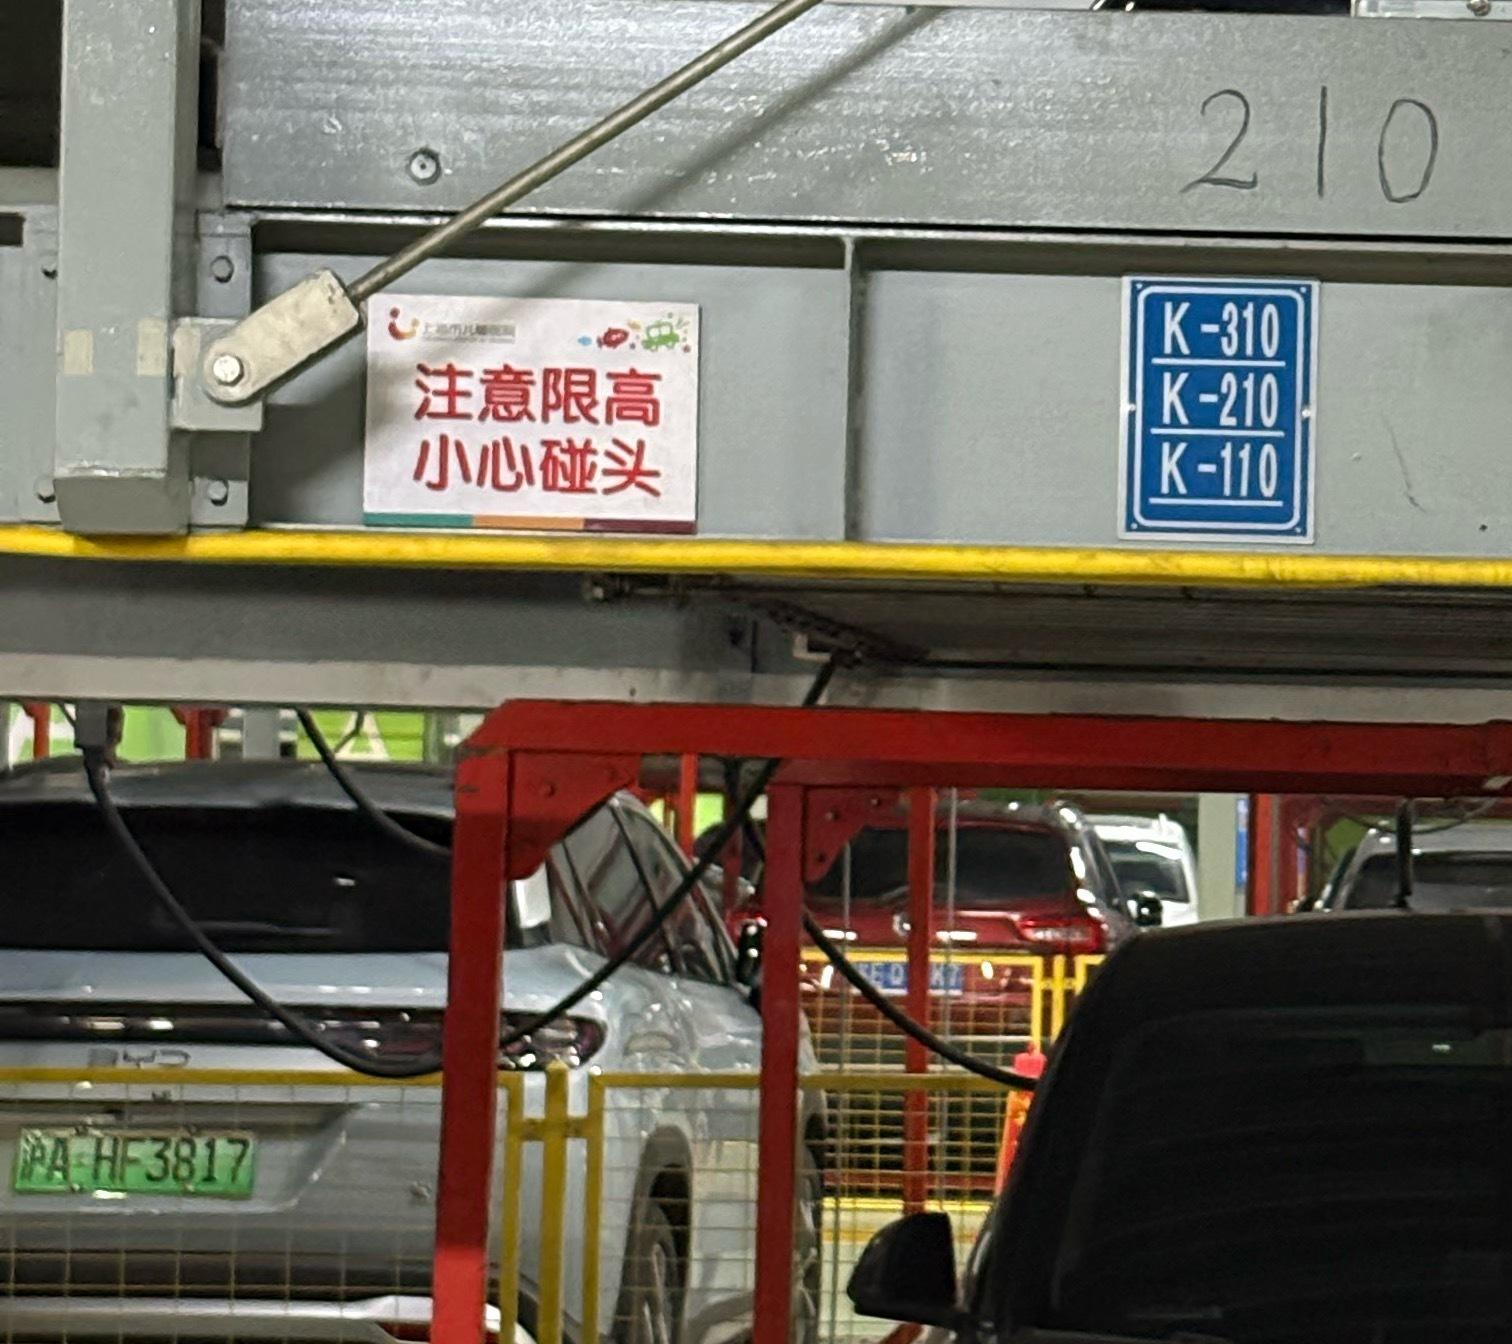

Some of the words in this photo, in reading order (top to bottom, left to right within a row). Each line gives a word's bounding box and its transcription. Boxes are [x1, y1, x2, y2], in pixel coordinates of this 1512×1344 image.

[1180, 85, 1439, 204] 210
[1161, 300, 1281, 359] K-310
[413, 362, 663, 428] 注意限高
[1160, 370, 1280, 429] K-210
[412, 433, 662, 498] 小心碰头
[1159, 440, 1279, 499] K-110
